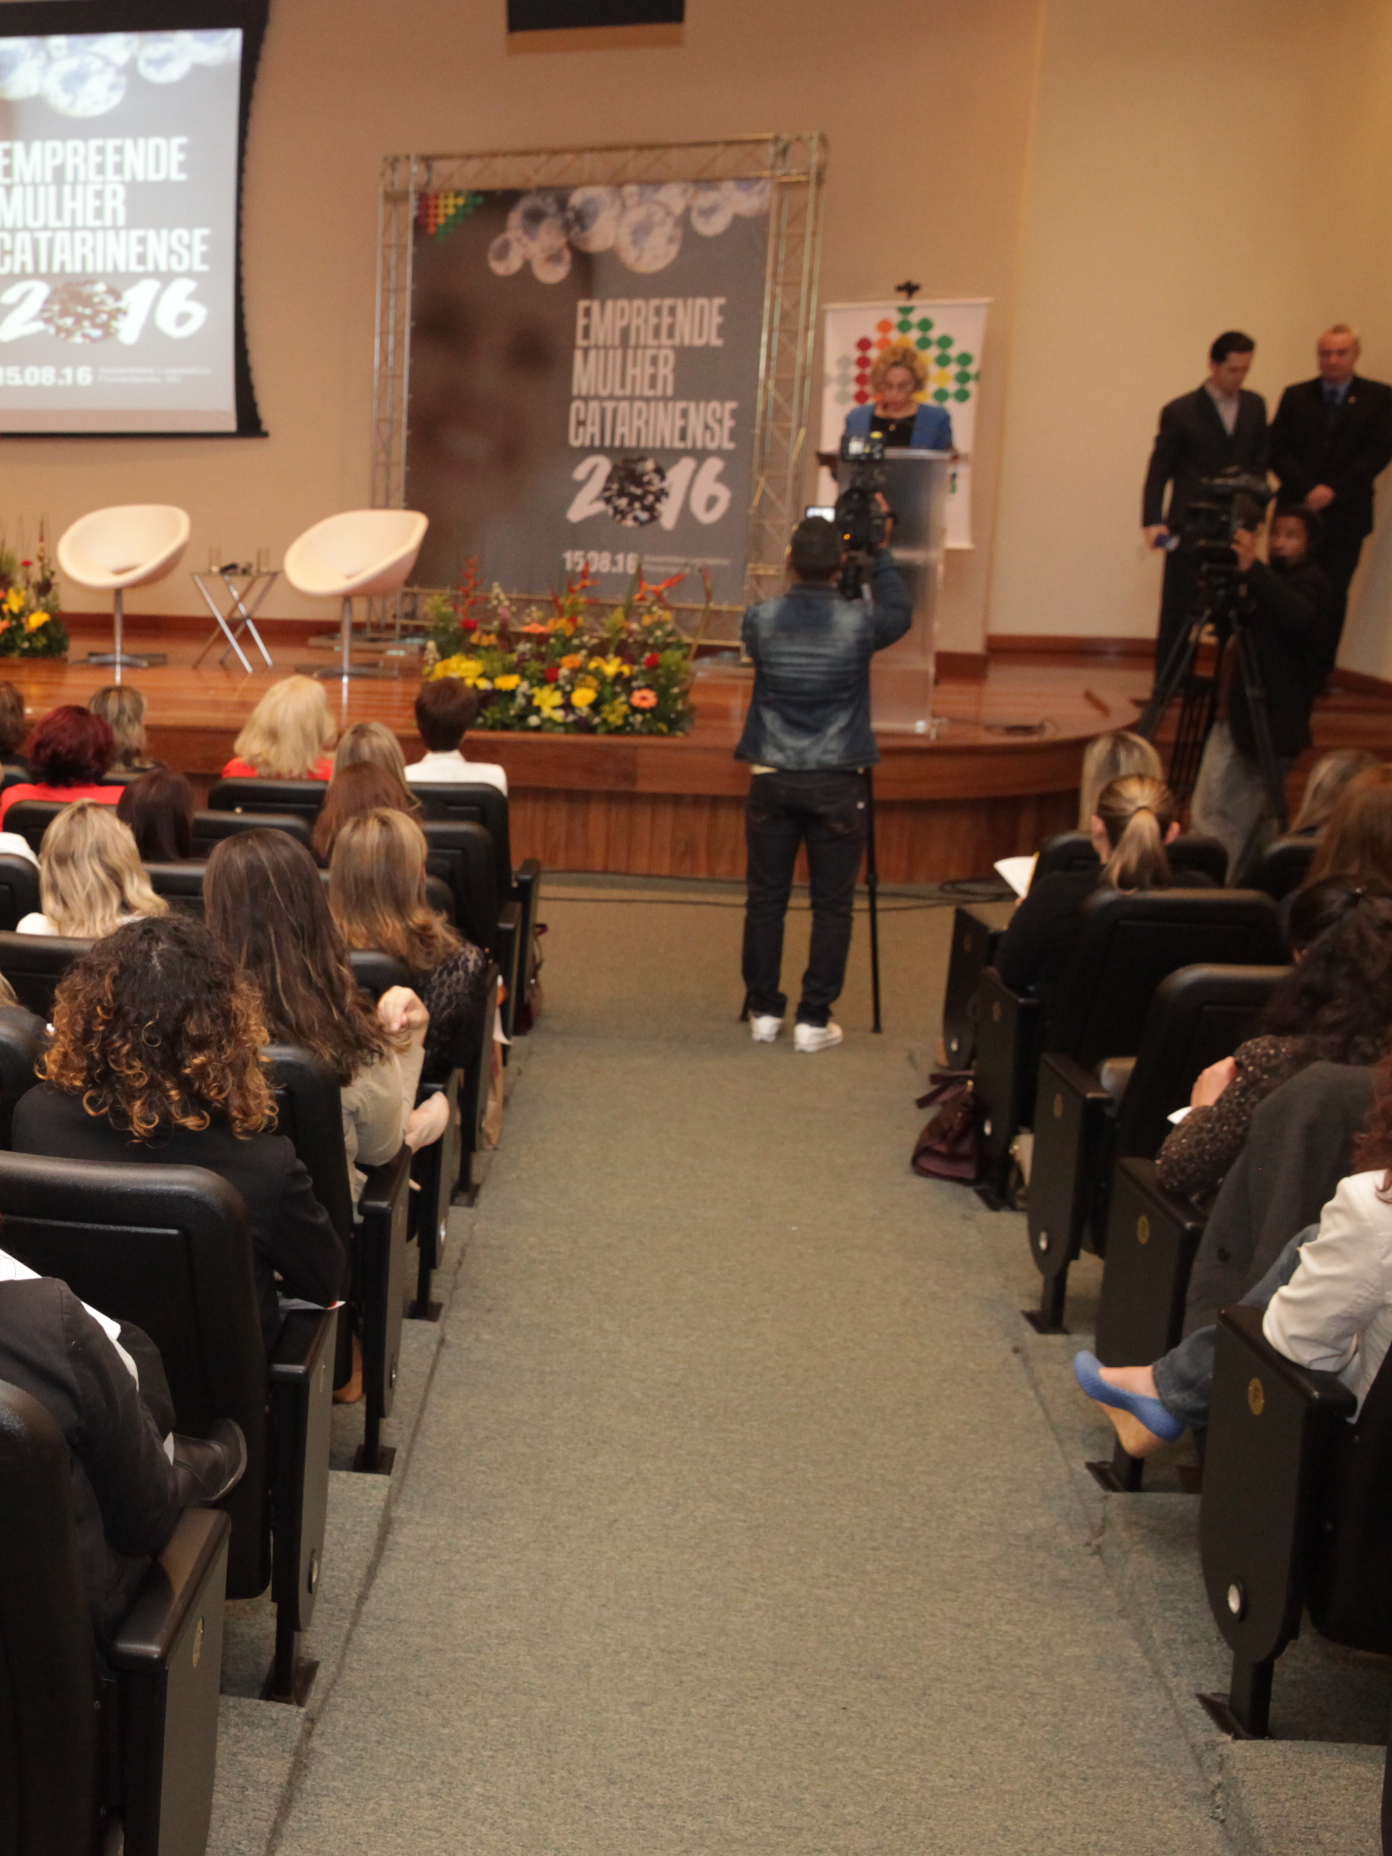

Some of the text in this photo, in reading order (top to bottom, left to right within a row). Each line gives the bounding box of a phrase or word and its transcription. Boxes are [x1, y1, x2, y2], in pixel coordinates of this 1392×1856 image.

[577, 299, 725, 346] EMPREENDE
[573, 350, 675, 396] MULHER
[570, 402, 738, 449] CATARINENSE
